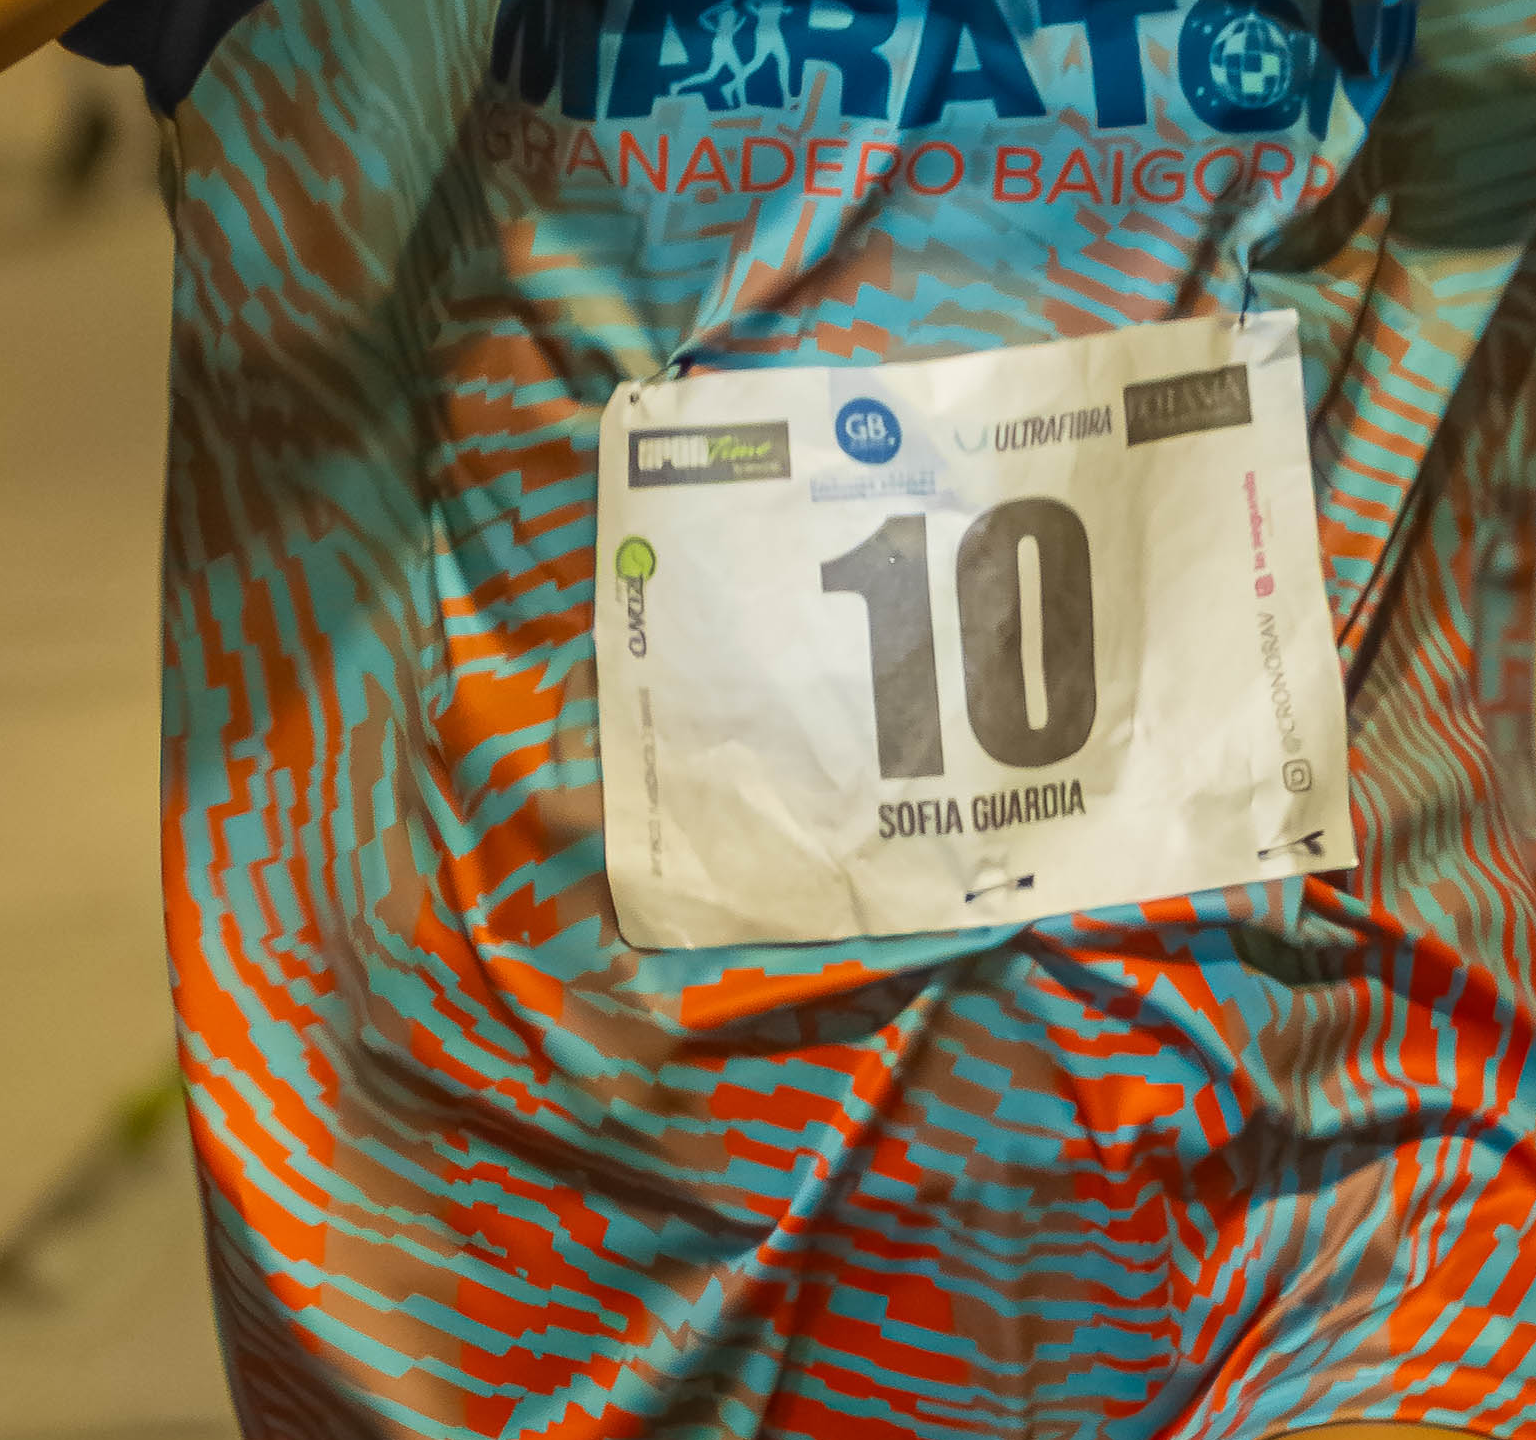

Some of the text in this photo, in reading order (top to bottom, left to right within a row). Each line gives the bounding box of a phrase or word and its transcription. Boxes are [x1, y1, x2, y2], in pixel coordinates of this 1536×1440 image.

[481, 118, 1339, 212] GRANADERO BAIGORR
[995, 404, 1113, 452] ULTRAFIBRA
[820, 496, 1097, 779] 10
[877, 778, 1087, 840] SOFIA GUARDIA
